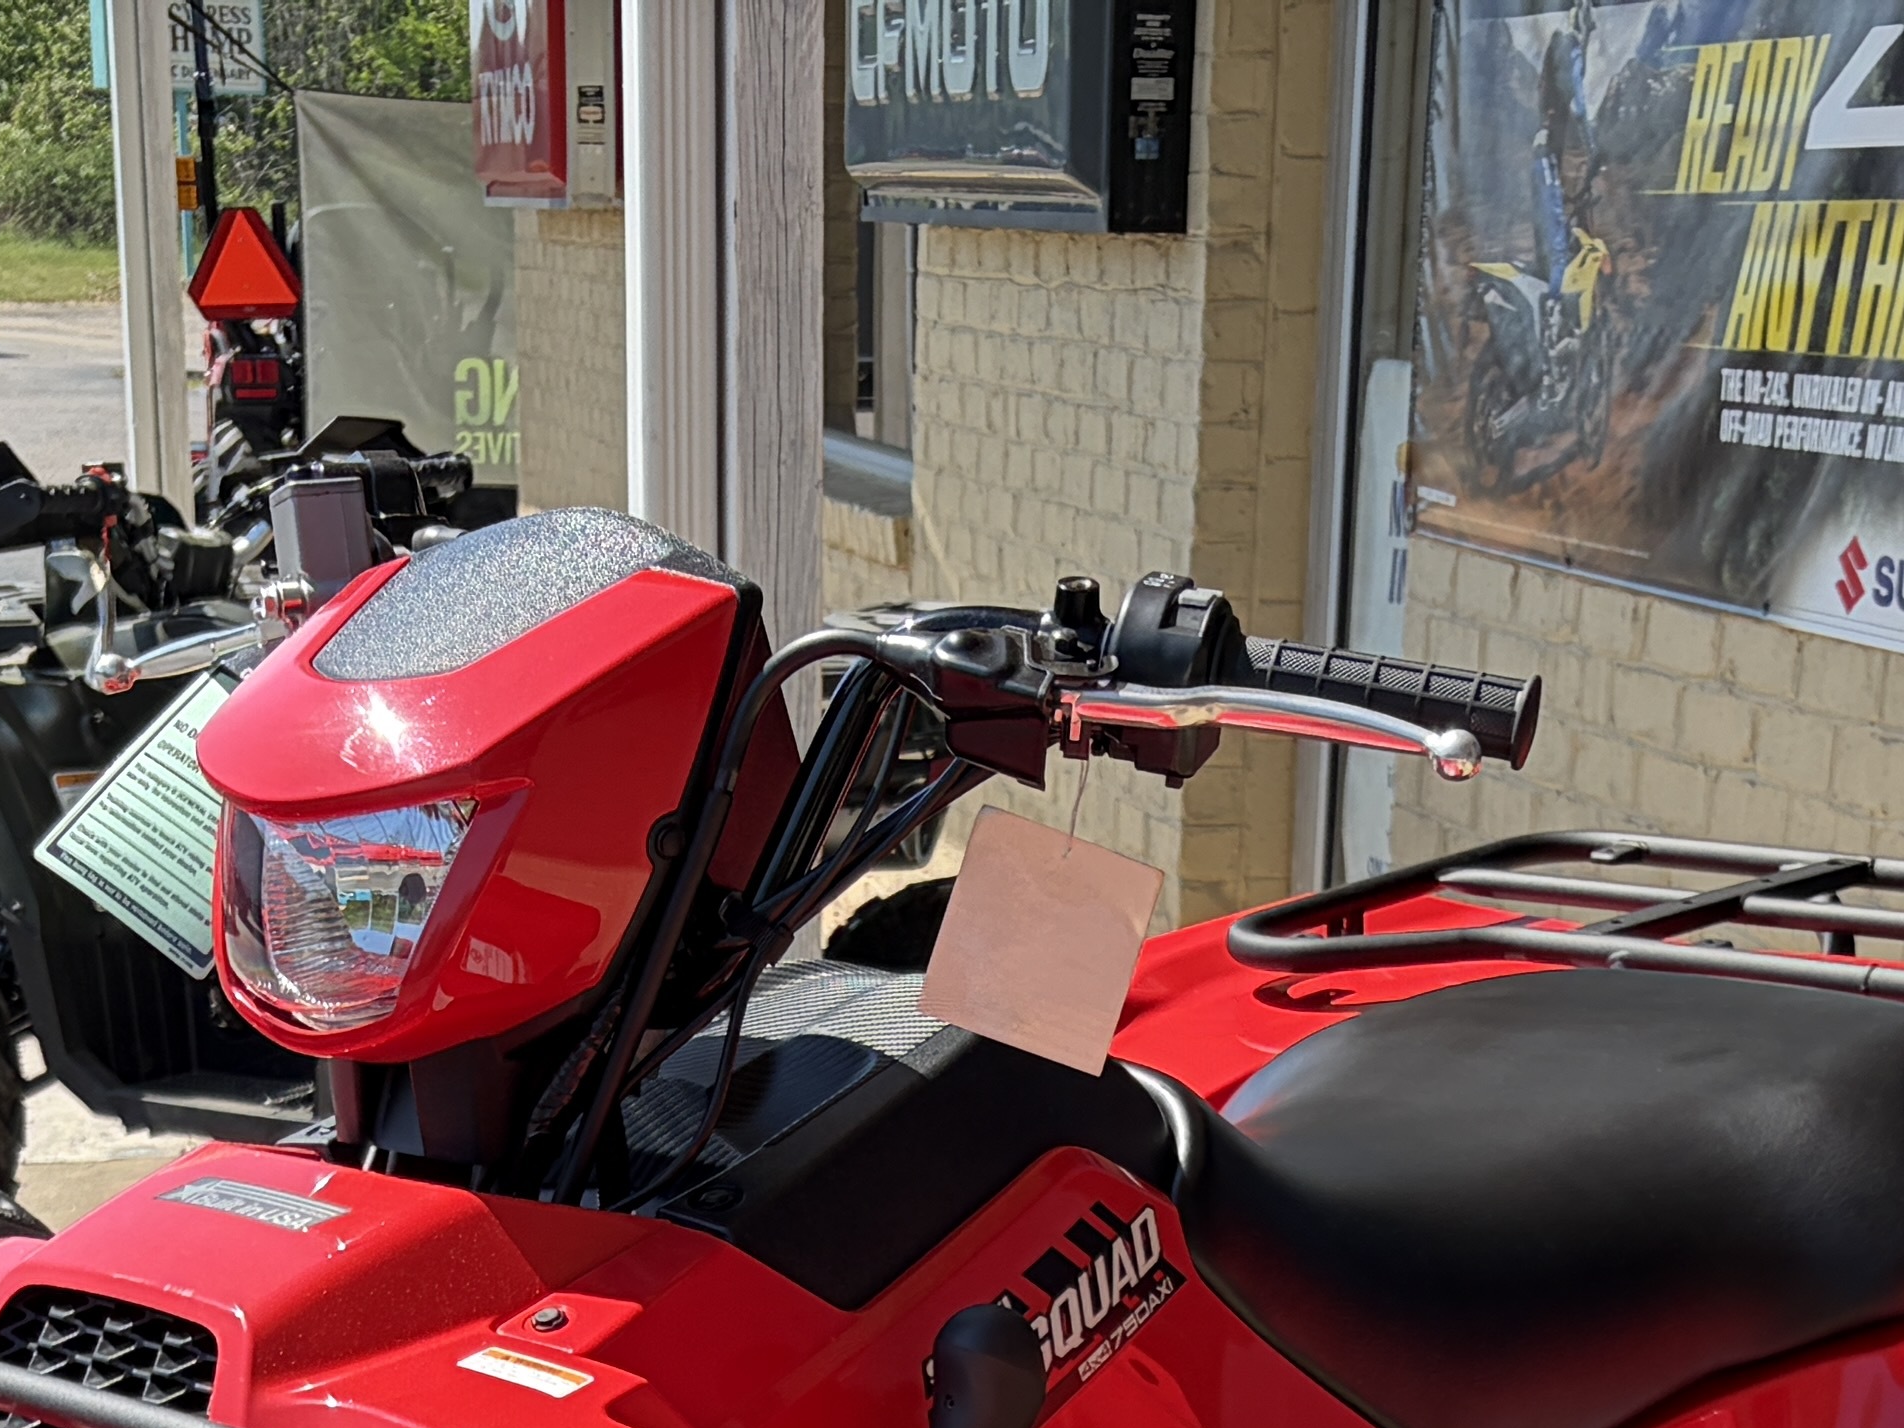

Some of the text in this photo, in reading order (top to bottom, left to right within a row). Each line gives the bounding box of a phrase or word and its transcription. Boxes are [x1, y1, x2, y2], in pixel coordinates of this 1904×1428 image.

[851, 0, 1049, 105] CFMOTO
[1676, 34, 1830, 193] READY
[1032, 1206, 1162, 1373] QUAD
